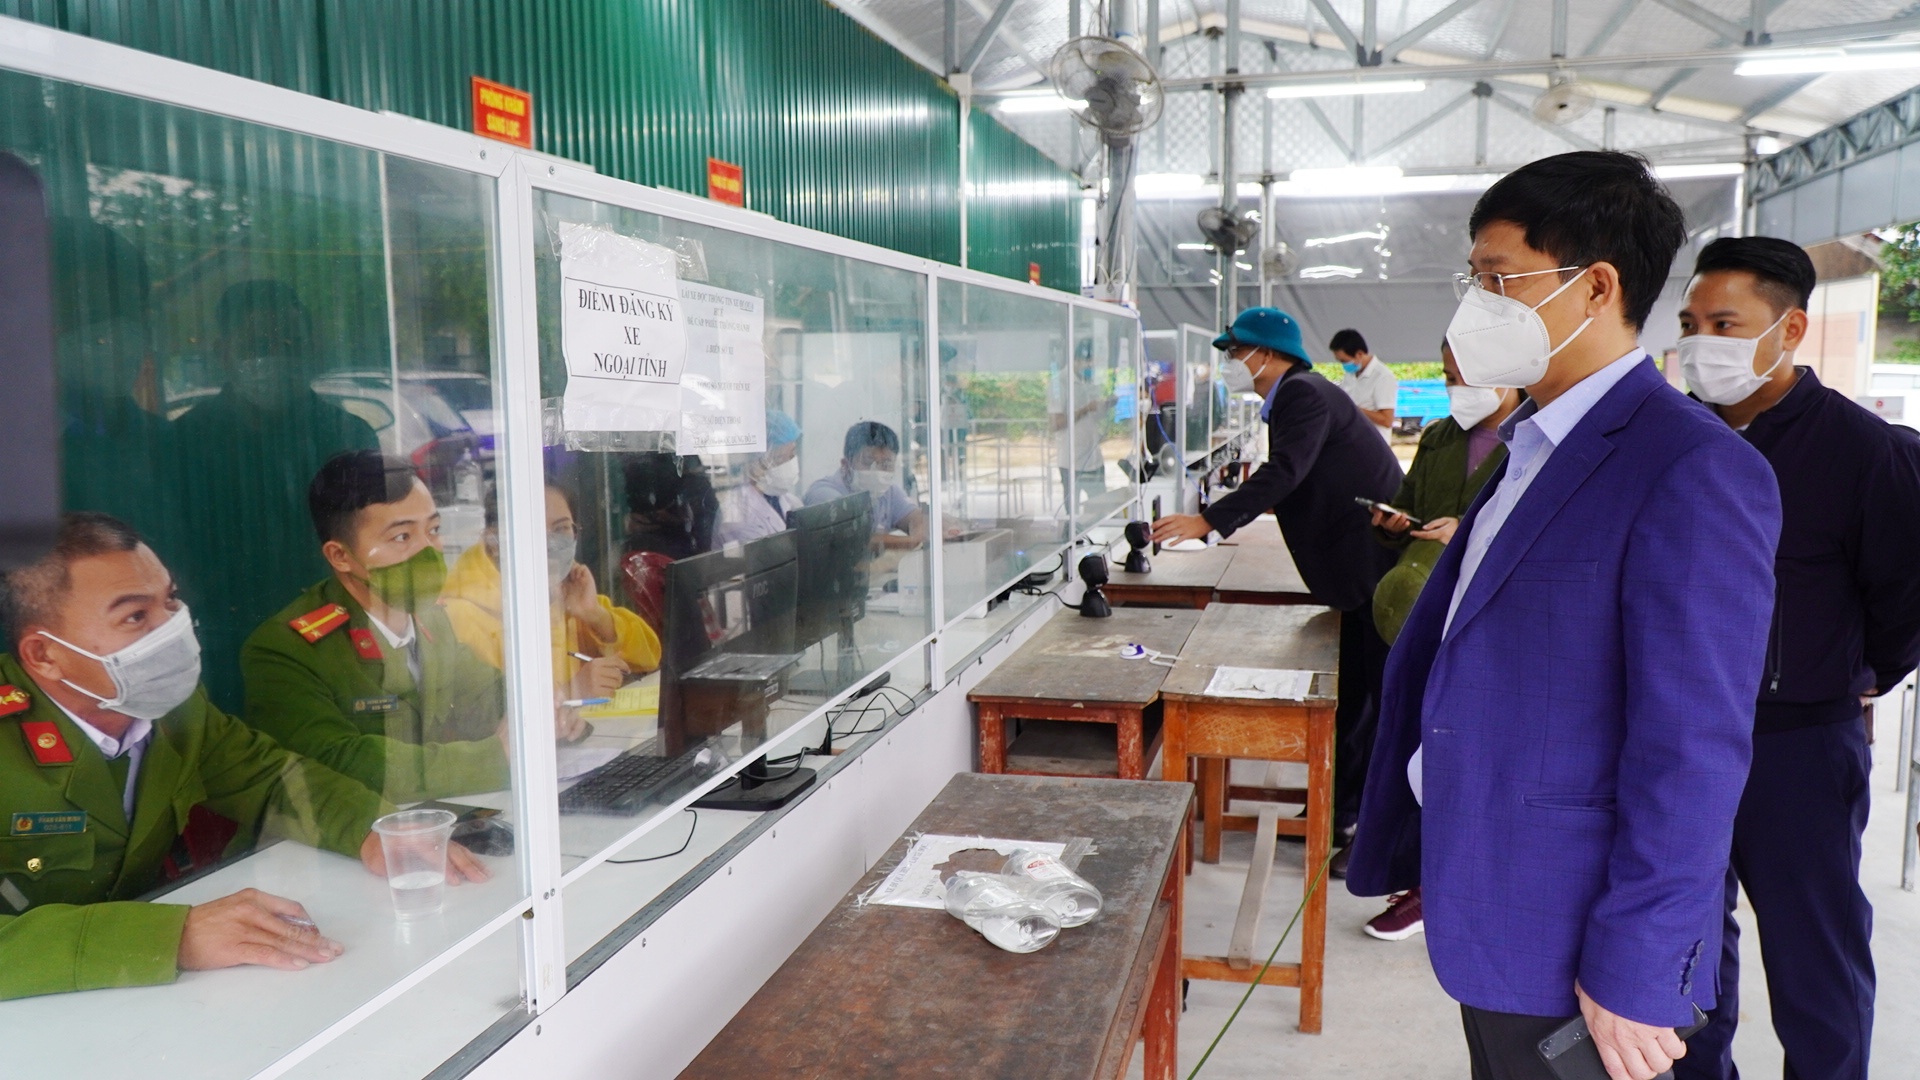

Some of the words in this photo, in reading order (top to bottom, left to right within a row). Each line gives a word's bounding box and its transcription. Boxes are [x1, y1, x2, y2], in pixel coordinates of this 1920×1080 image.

[578, 286, 615, 313] ĐIỂM
[619, 292, 655, 319] ĐĂNG
[657, 299, 674, 322] KÝ
[624, 326, 641, 346] XE
[593, 353, 636, 379] NGOẠI
[638, 353, 667, 378] TỈNH
